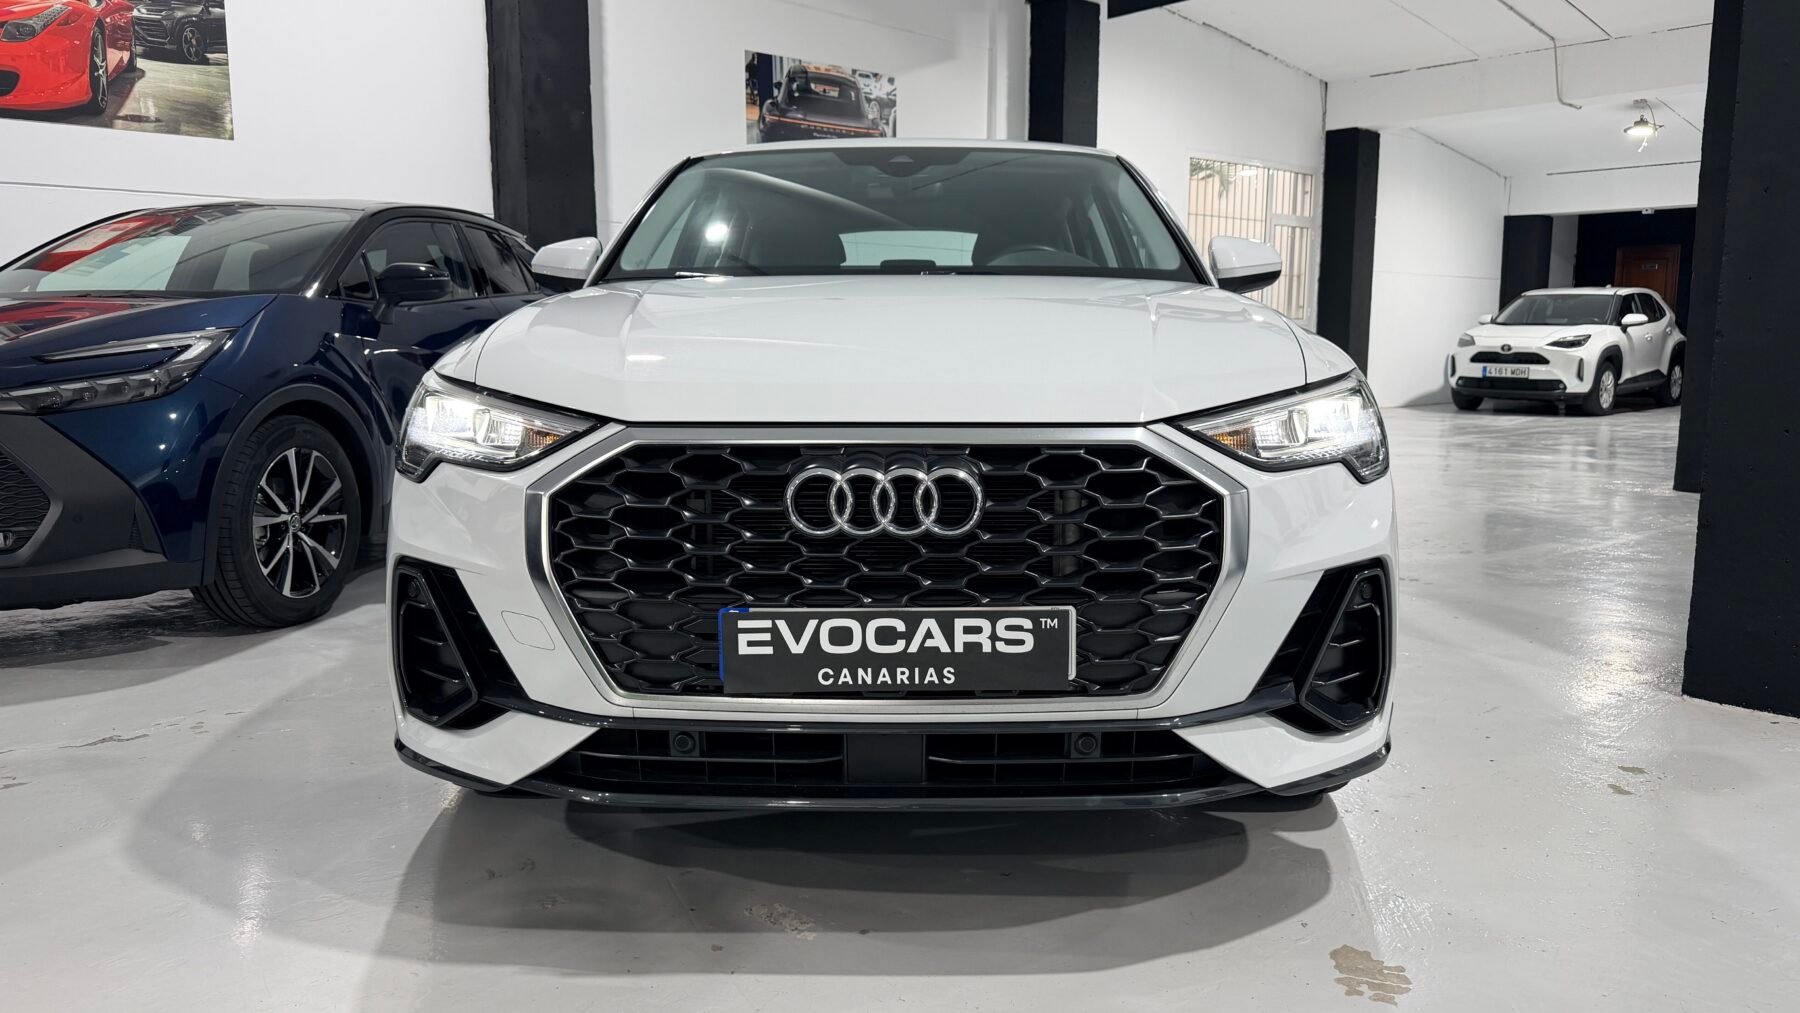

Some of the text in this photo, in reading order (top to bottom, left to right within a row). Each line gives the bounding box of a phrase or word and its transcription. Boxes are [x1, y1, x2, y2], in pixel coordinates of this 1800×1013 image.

[1488, 367, 1508, 376] 4161
[737, 617, 1035, 655] EVOCARS
[817, 667, 956, 686] CANARIAS
